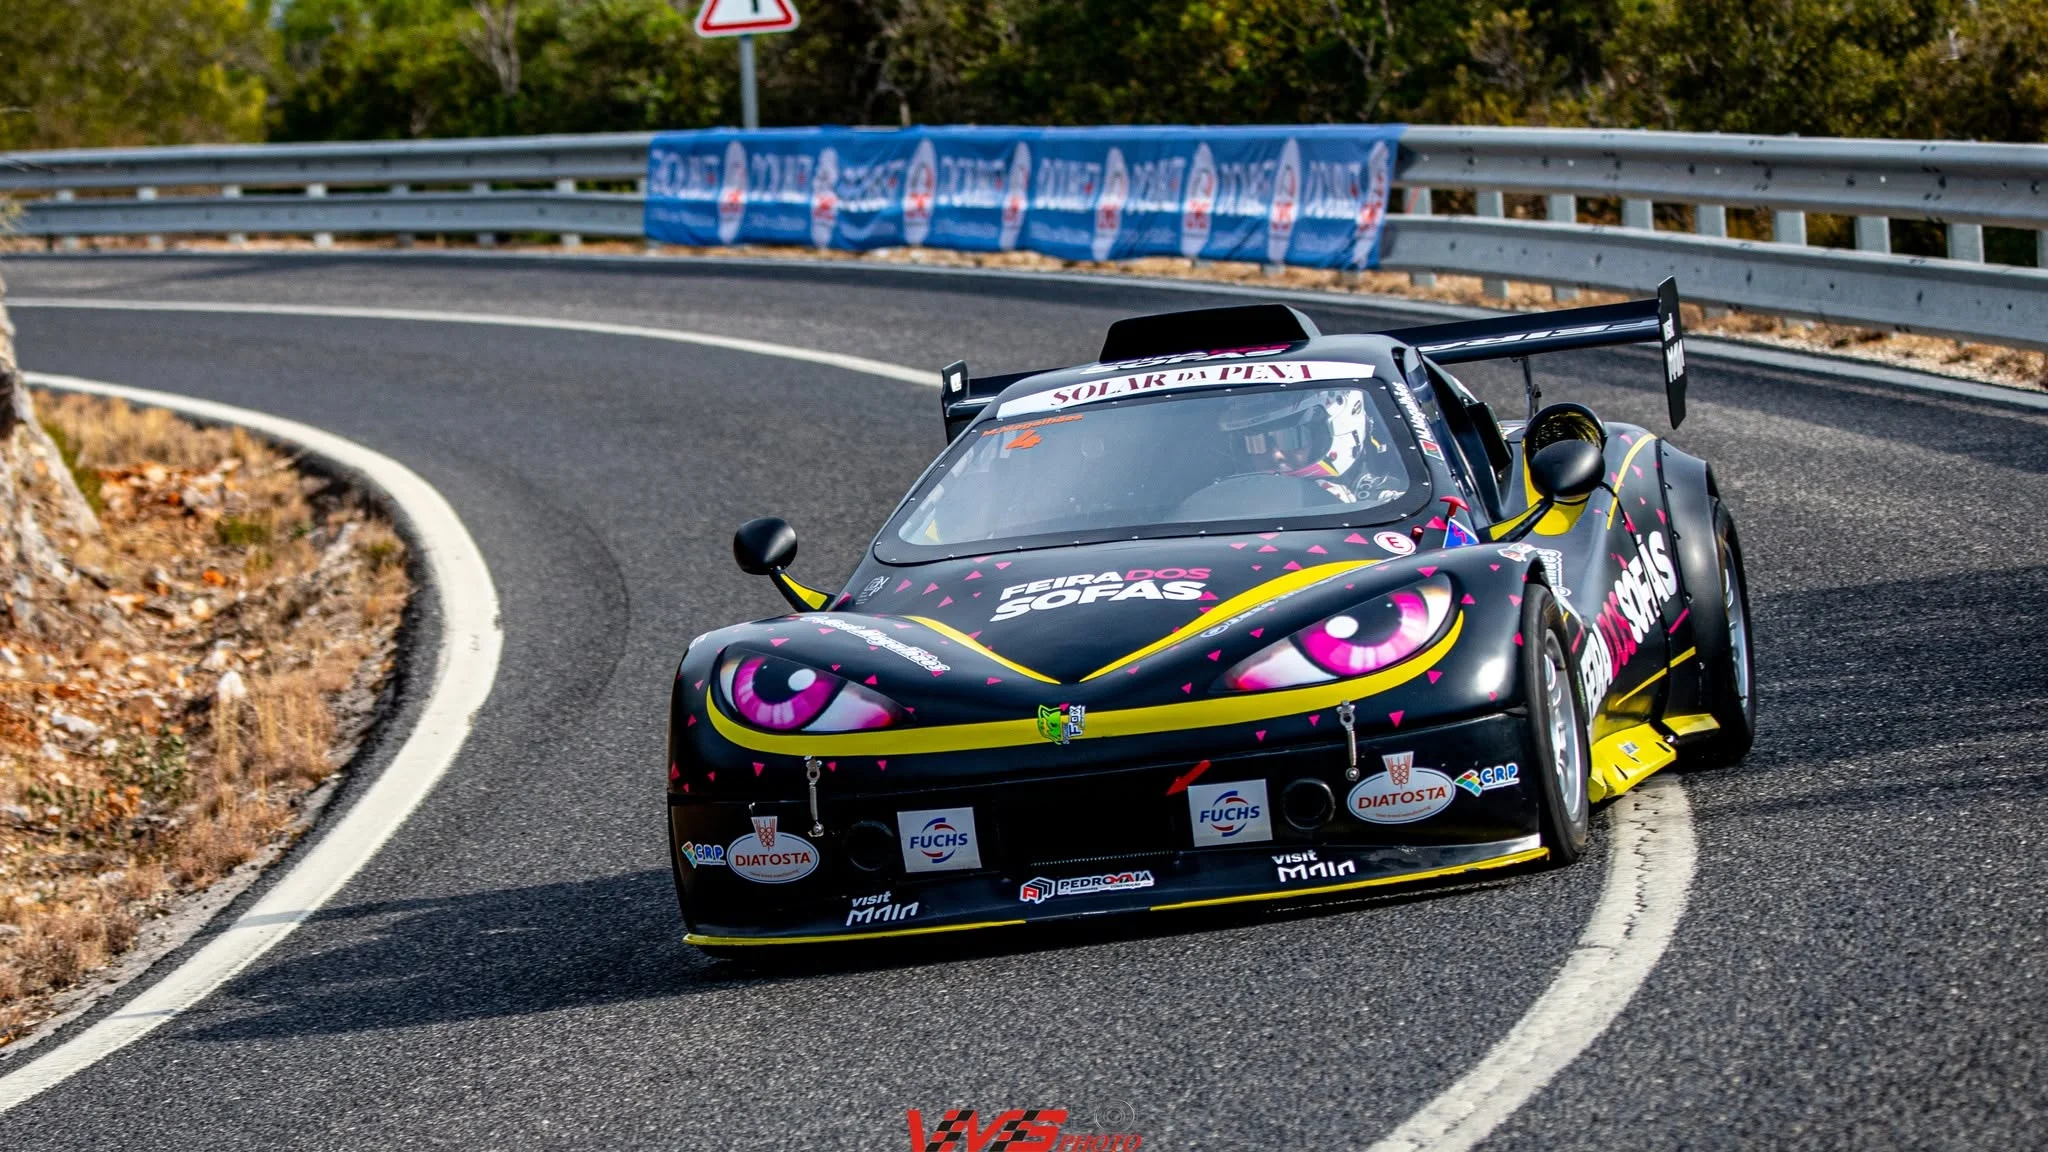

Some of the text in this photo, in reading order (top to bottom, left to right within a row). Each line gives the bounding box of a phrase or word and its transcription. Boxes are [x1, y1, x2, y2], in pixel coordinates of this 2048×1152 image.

[1050, 373, 1167, 405] SOLAR
[1177, 370, 1207, 381] DA
[1005, 428, 1043, 450] 4
[1386, 535, 1405, 550] E
[1000, 568, 1213, 601] FEIRA DOS
[1614, 531, 1678, 644] SOFÁS
[989, 579, 1208, 622] SOFÁS
[1480, 762, 1519, 784] CRP
[1357, 786, 1447, 810] DIATOSTA
[1199, 804, 1261, 823] FUCHS
[909, 831, 969, 850] FUCHS
[694, 843, 725, 860] CRP
[735, 852, 812, 867] DIATOSTA
[1271, 849, 1318, 865] visit
[851, 890, 892, 907] visit
